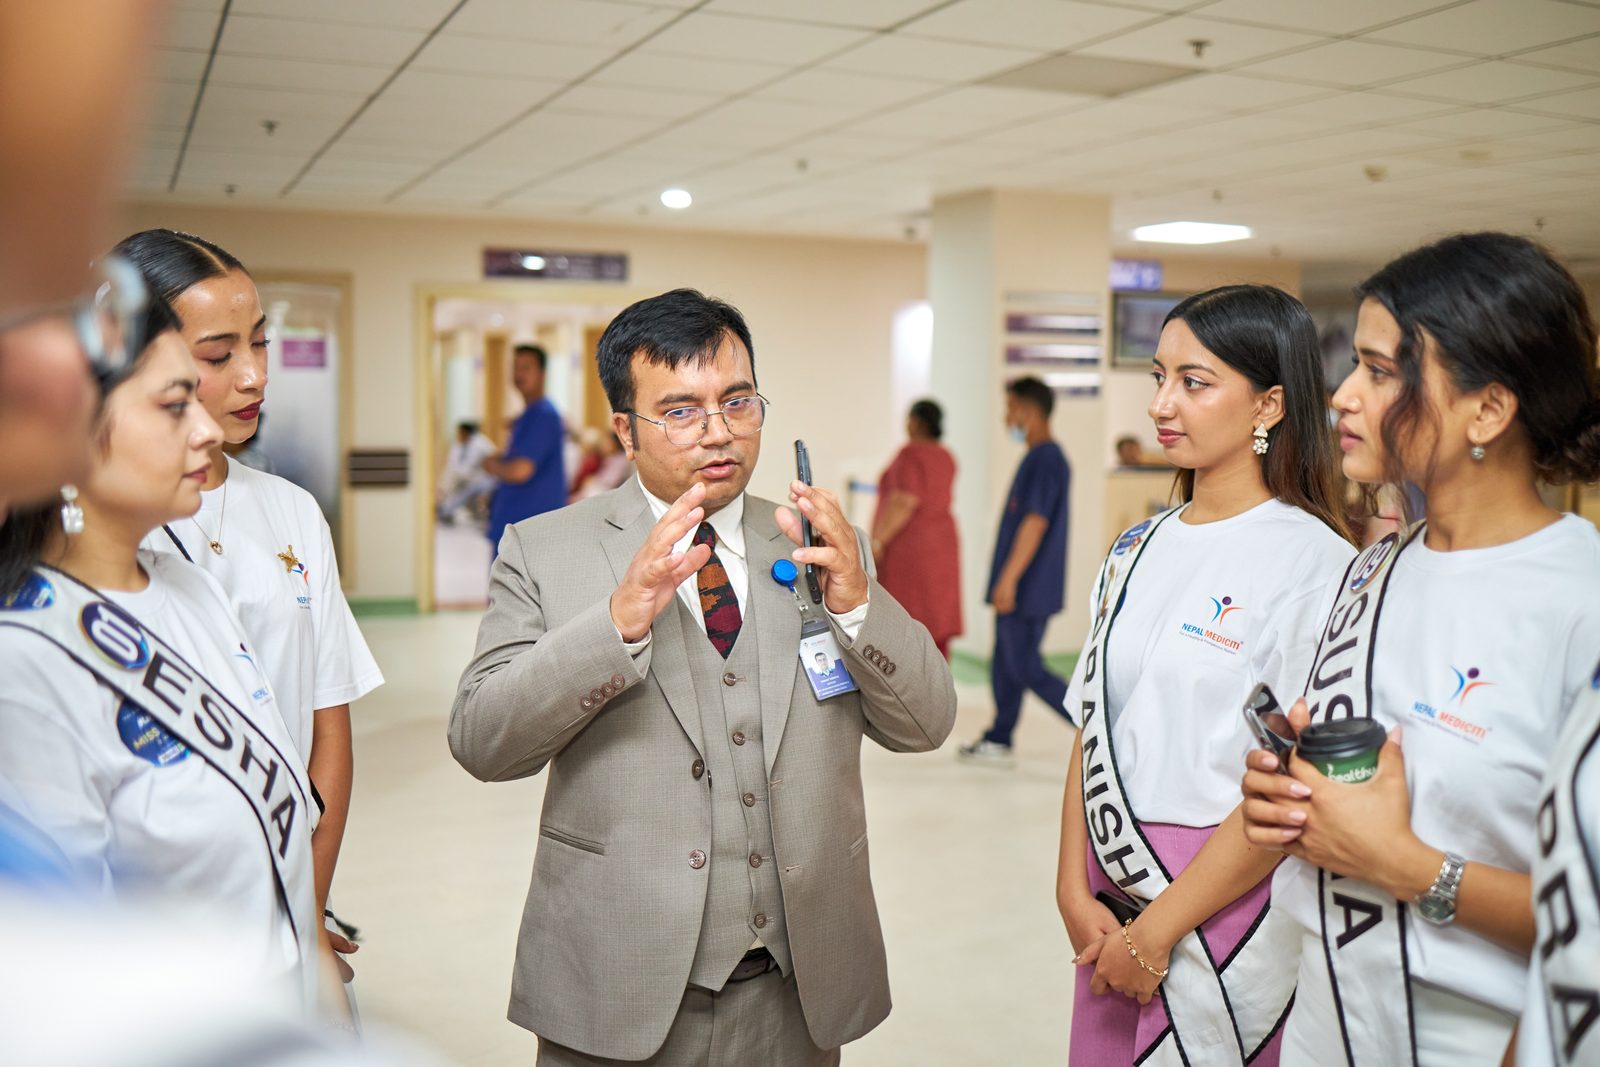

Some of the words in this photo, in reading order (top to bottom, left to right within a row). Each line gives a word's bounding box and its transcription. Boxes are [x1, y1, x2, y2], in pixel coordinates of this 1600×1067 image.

[1353, 540, 1393, 580] 09
[1182, 623, 1203, 636] NEPAL
[1204, 630, 1240, 649] MEDICITI
[1414, 701, 1437, 719] NEPAL
[1439, 711, 1487, 738] MEDICITI
[142, 651, 297, 860] ESHA
